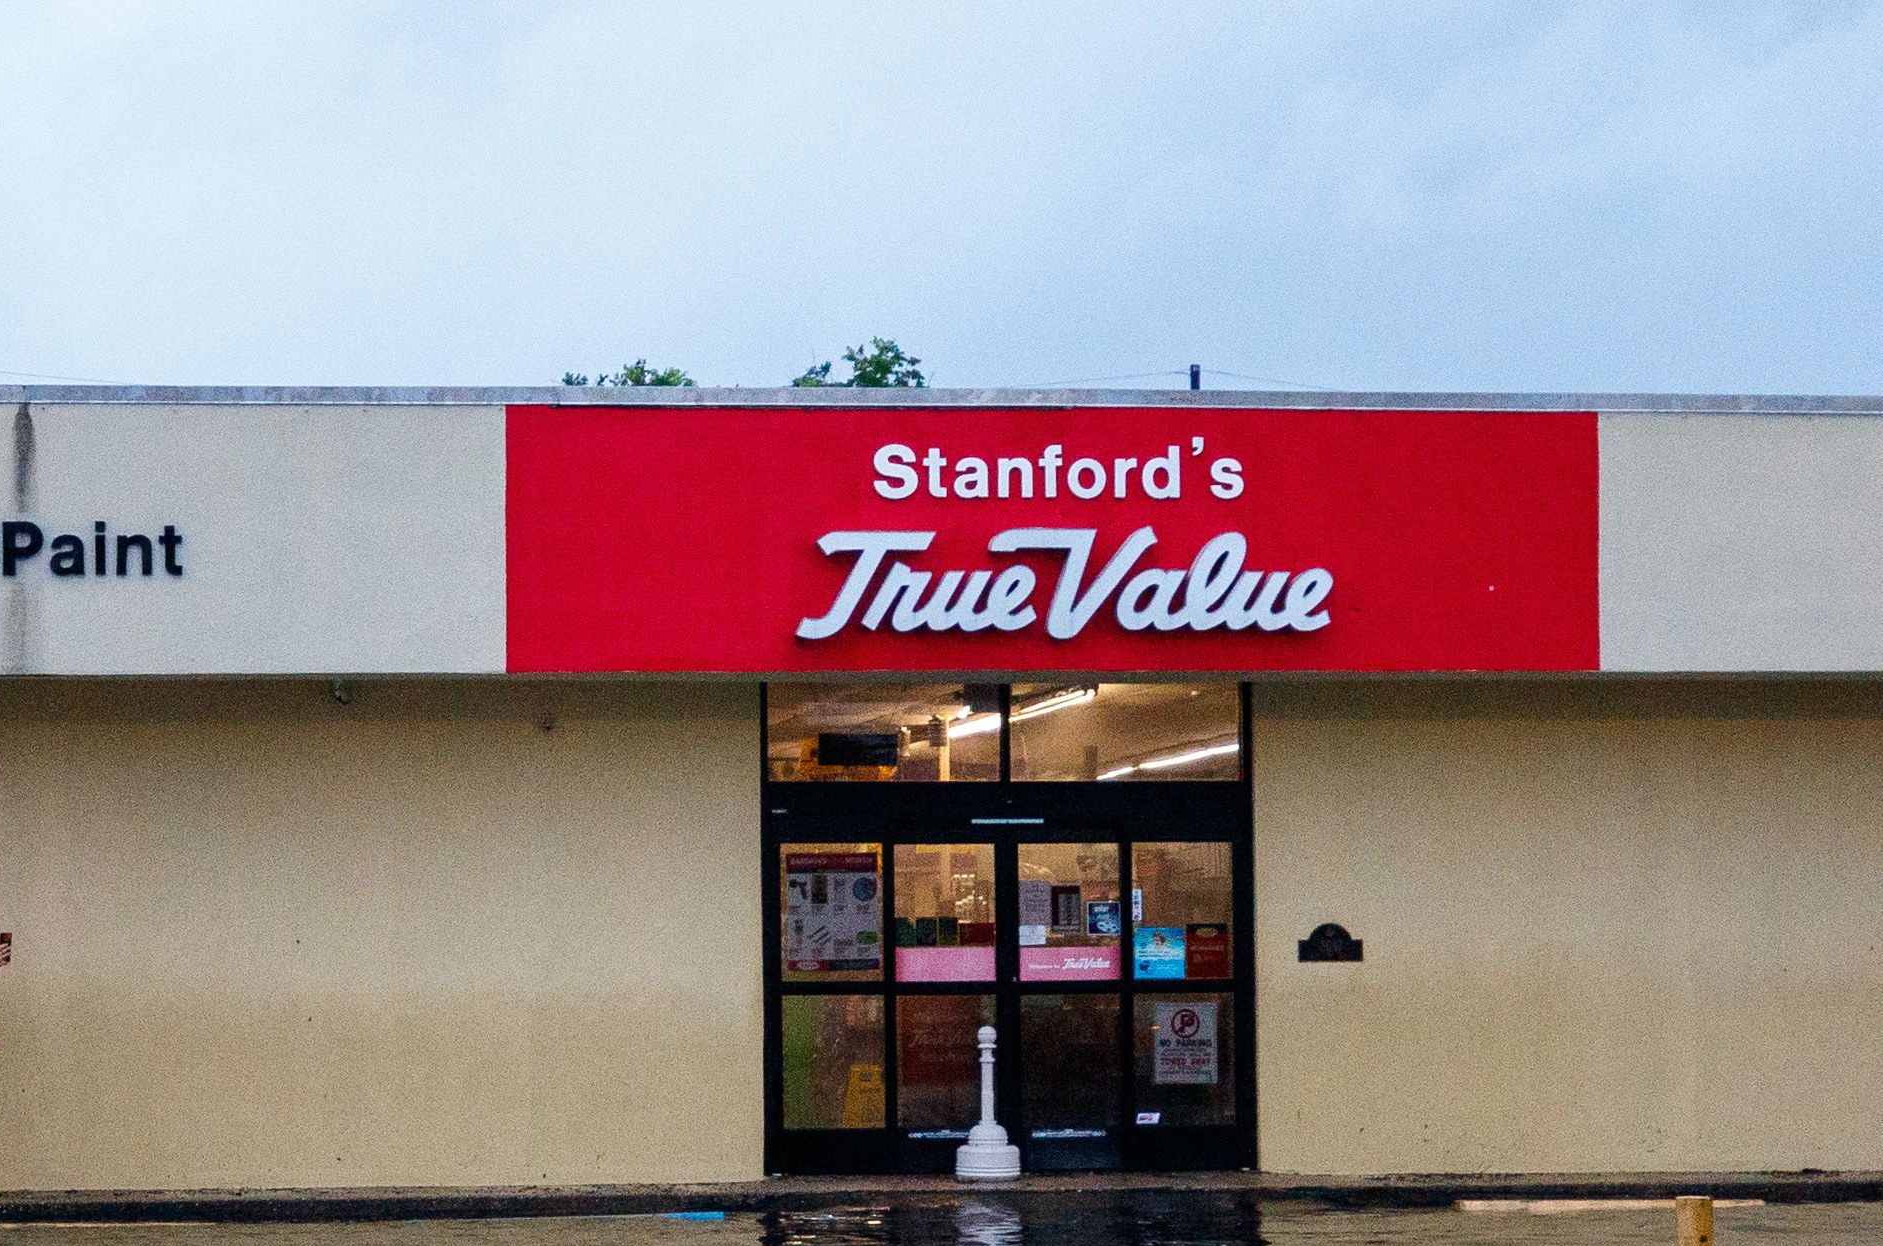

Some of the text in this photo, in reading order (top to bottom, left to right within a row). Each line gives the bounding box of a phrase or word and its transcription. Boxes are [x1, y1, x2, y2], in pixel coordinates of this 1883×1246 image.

[872, 436, 1246, 500] Stanford's
[1, 520, 183, 577] Paint
[1159, 1039, 1171, 1047] NO
